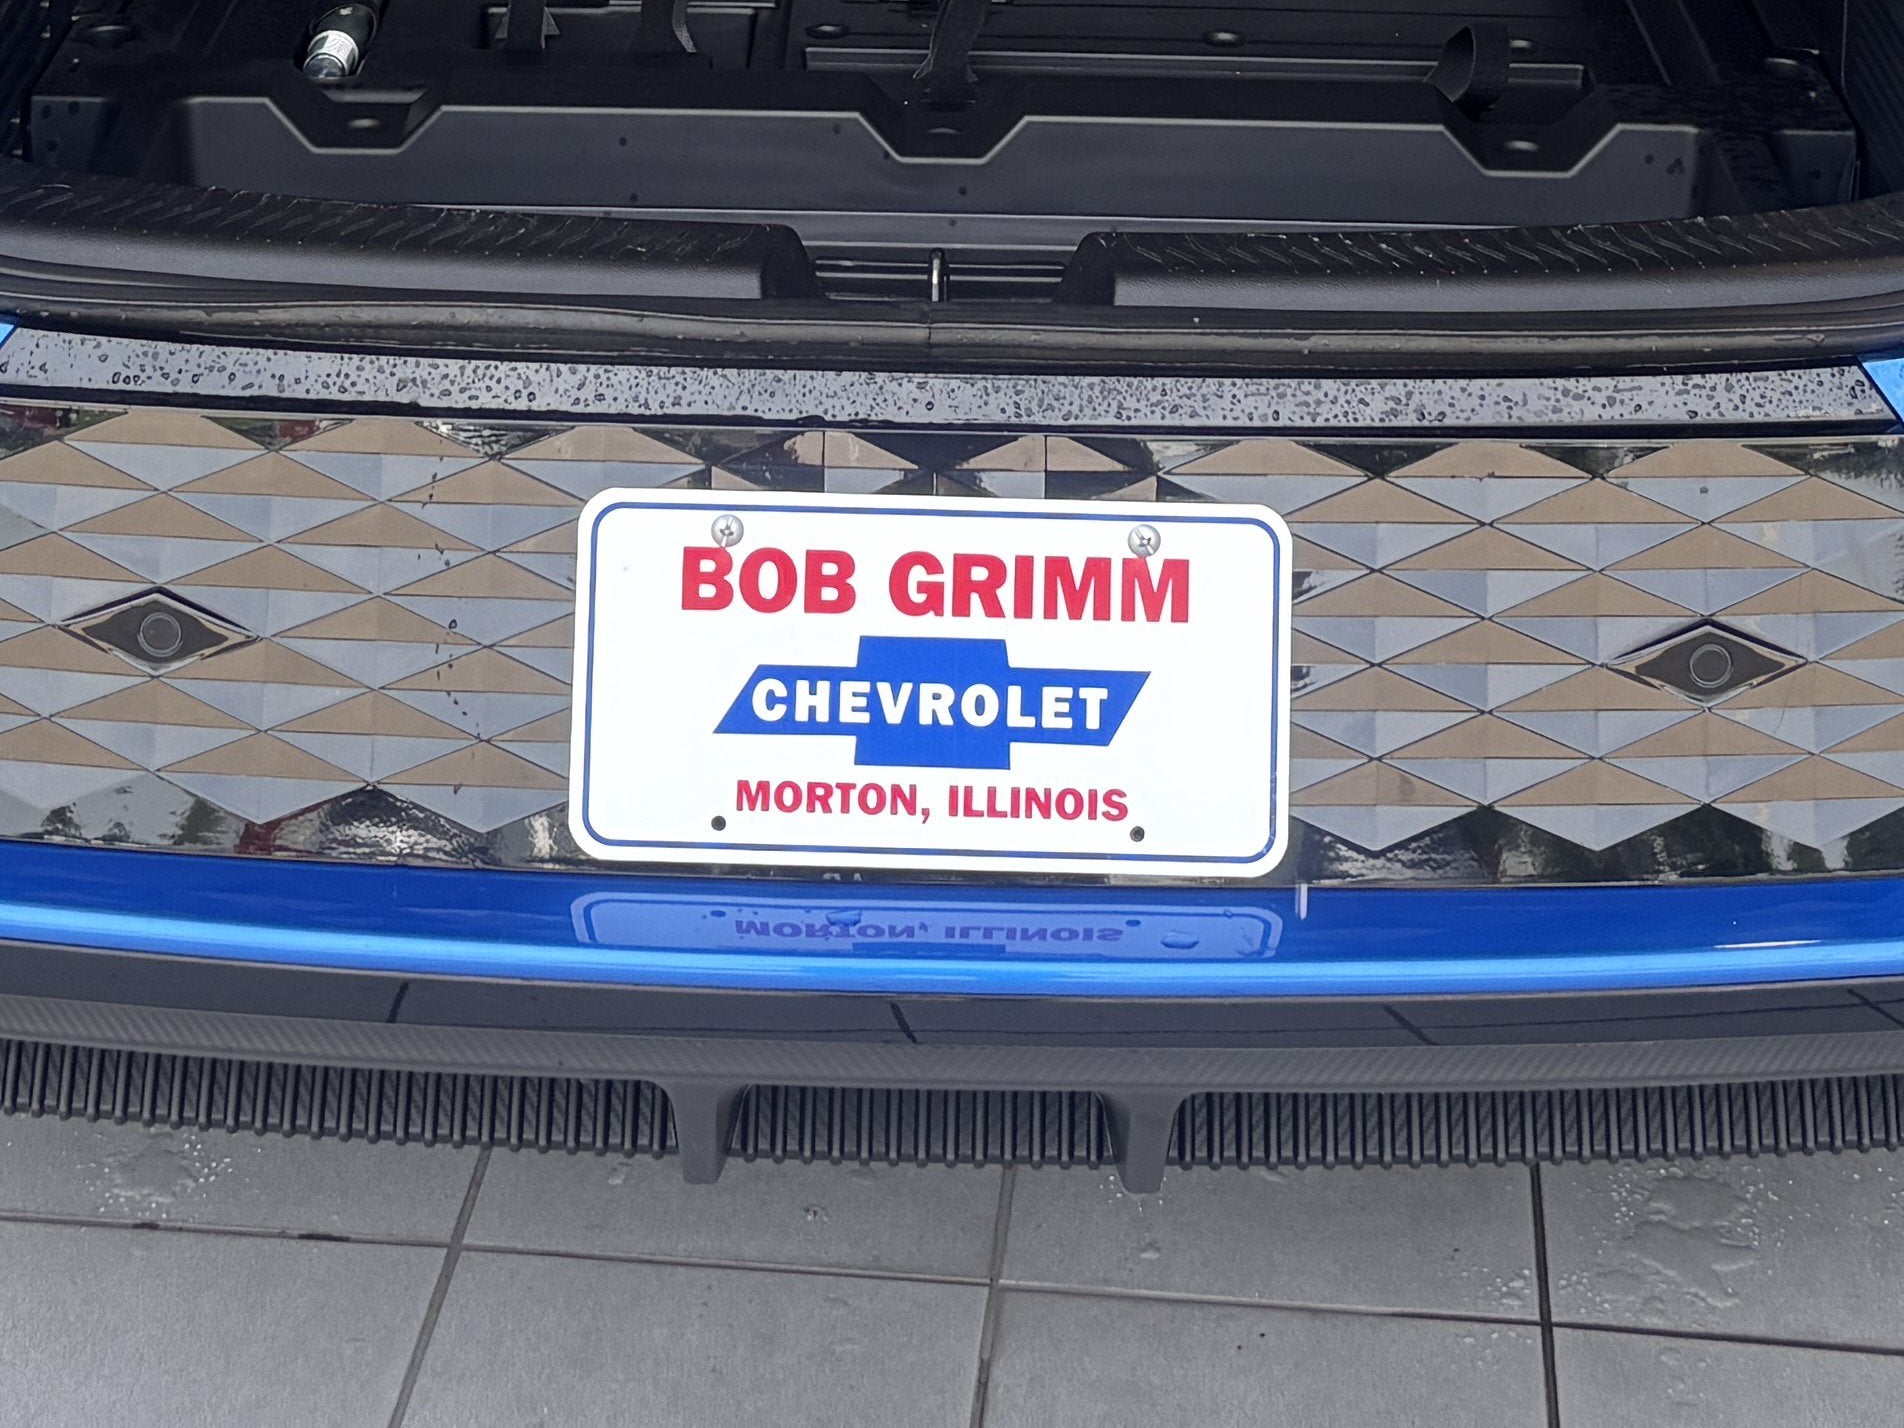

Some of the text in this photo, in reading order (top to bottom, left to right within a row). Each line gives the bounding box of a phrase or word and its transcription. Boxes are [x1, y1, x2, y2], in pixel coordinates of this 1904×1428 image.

[680, 546, 1190, 623] BOB GRIMM
[751, 678, 1110, 730] CHEVROLET
[736, 780, 1129, 824] MORTON, ILLINOIS
